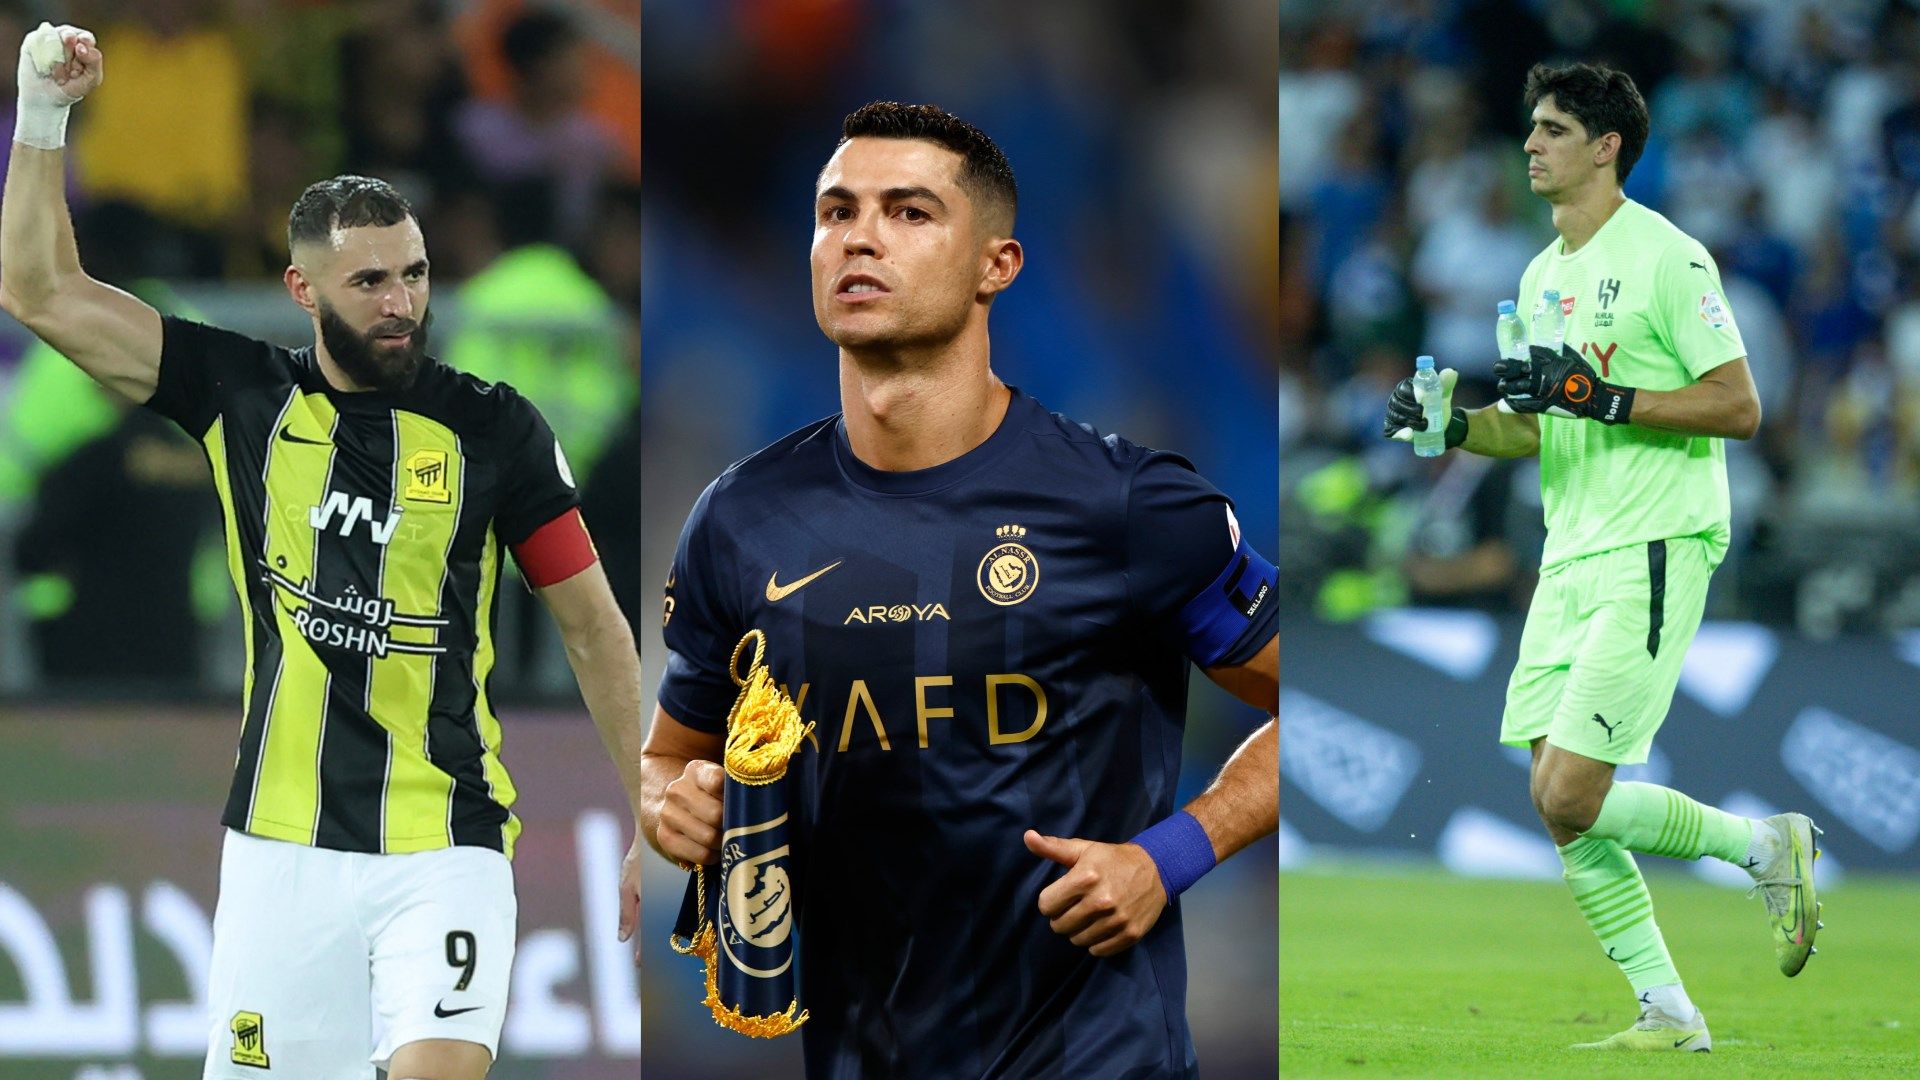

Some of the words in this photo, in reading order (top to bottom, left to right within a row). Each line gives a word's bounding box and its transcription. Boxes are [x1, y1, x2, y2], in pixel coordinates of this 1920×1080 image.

[1604, 395, 1621, 420] Bono
[988, 552, 1000, 564] AL
[1001, 546, 1031, 564] NASSR
[985, 584, 1013, 600] FOOTBALL
[1015, 584, 1030, 598] CLUB
[843, 603, 951, 625] AROYA
[294, 608, 388, 656] ROSHN
[445, 929, 477, 992] 9
